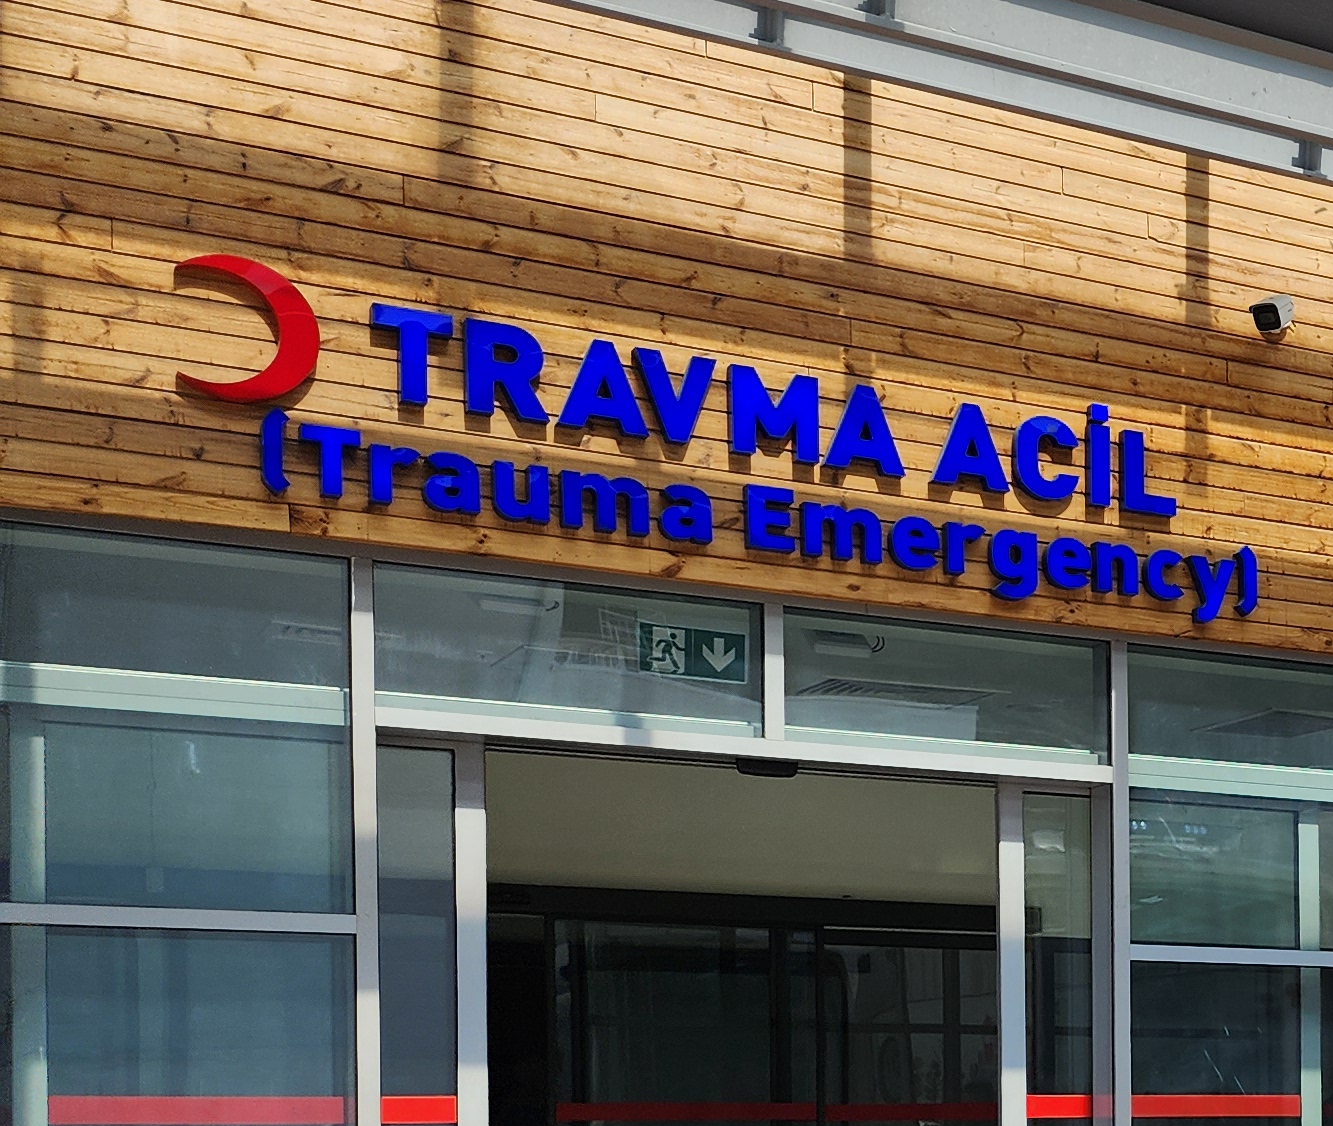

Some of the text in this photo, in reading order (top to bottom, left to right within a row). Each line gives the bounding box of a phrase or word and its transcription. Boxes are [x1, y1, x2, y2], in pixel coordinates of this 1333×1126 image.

[259, 407, 1260, 625] (Trauma Emergency)
[371, 301, 1178, 518] TRAVMA ACİL
